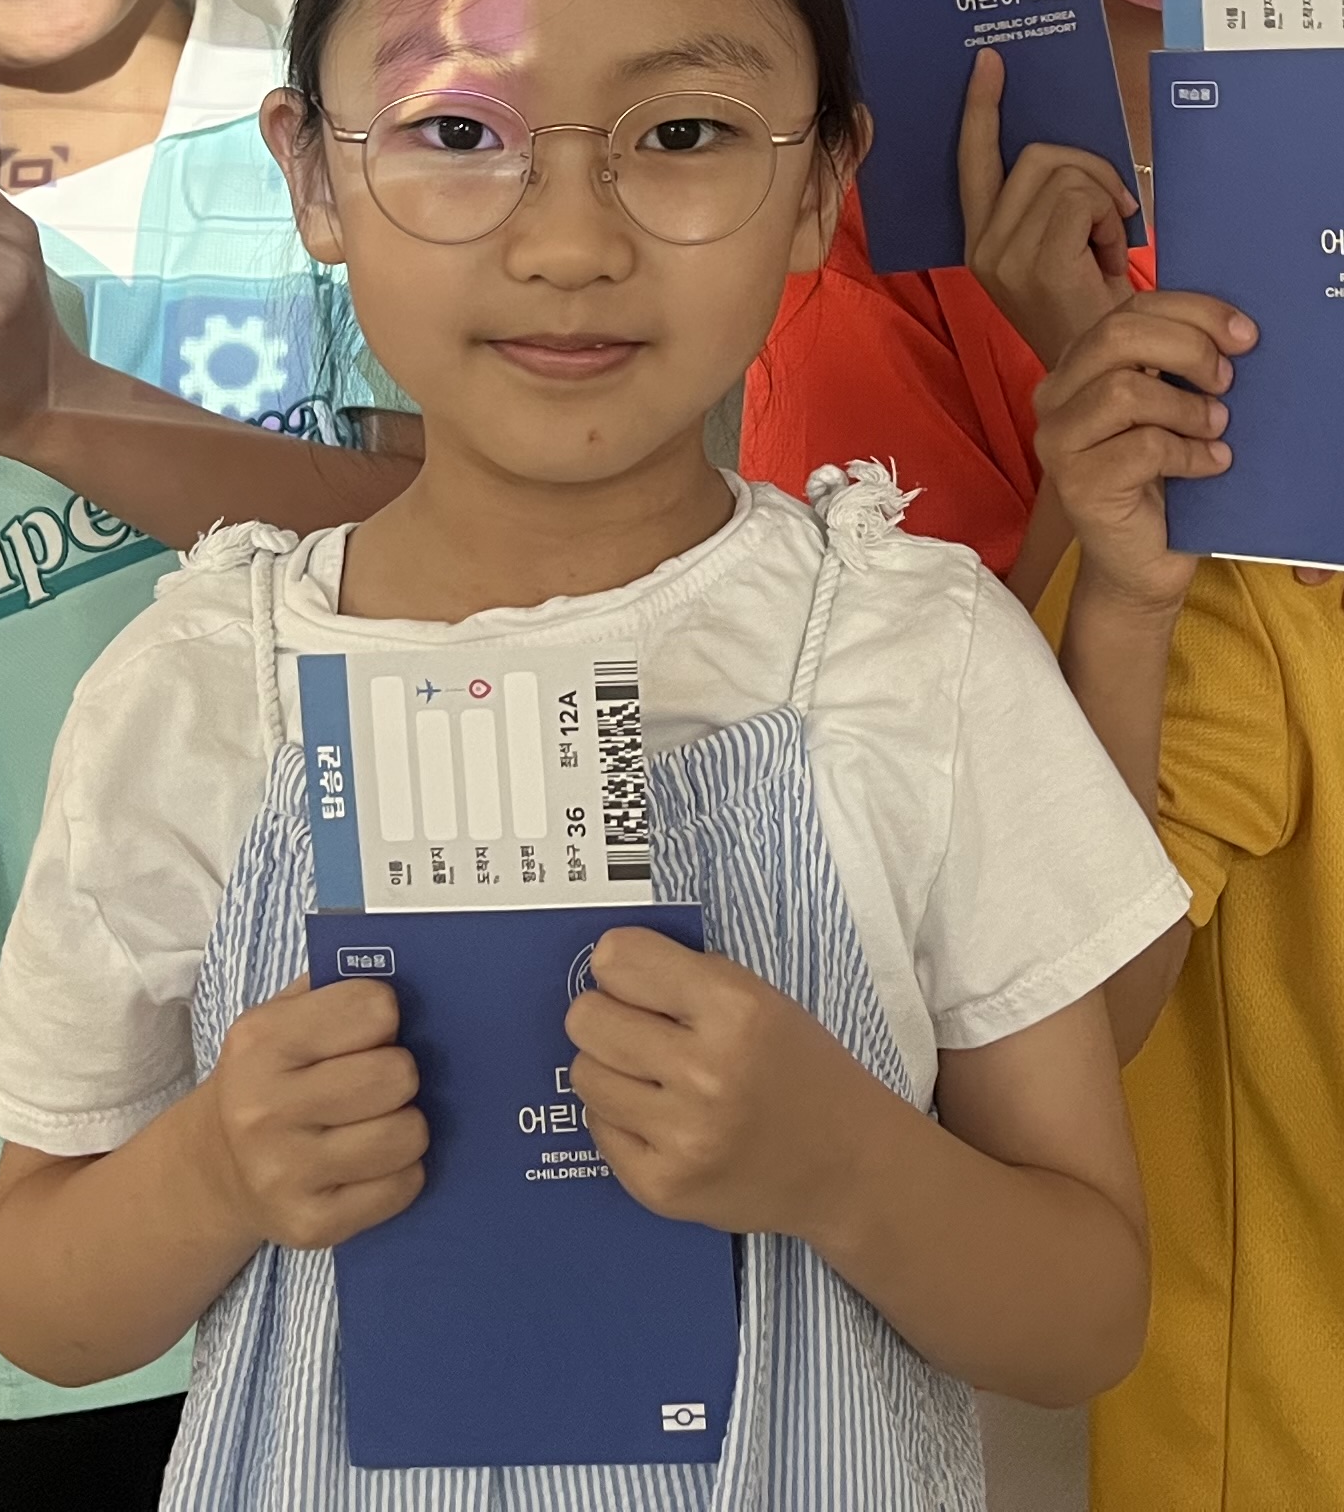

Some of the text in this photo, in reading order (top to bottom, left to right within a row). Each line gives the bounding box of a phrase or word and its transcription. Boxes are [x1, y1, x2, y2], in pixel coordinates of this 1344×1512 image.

[974, 18, 1024, 34] REPUBLIC
[1040, 10, 1076, 24] KOREA
[1025, 21, 1077, 39] PASSPORT
[558, 690, 579, 737] 12A
[316, 745, 346, 820] 탑승권
[566, 806, 586, 838] 36
[525, 1165, 609, 1181] CHILDREN'S
